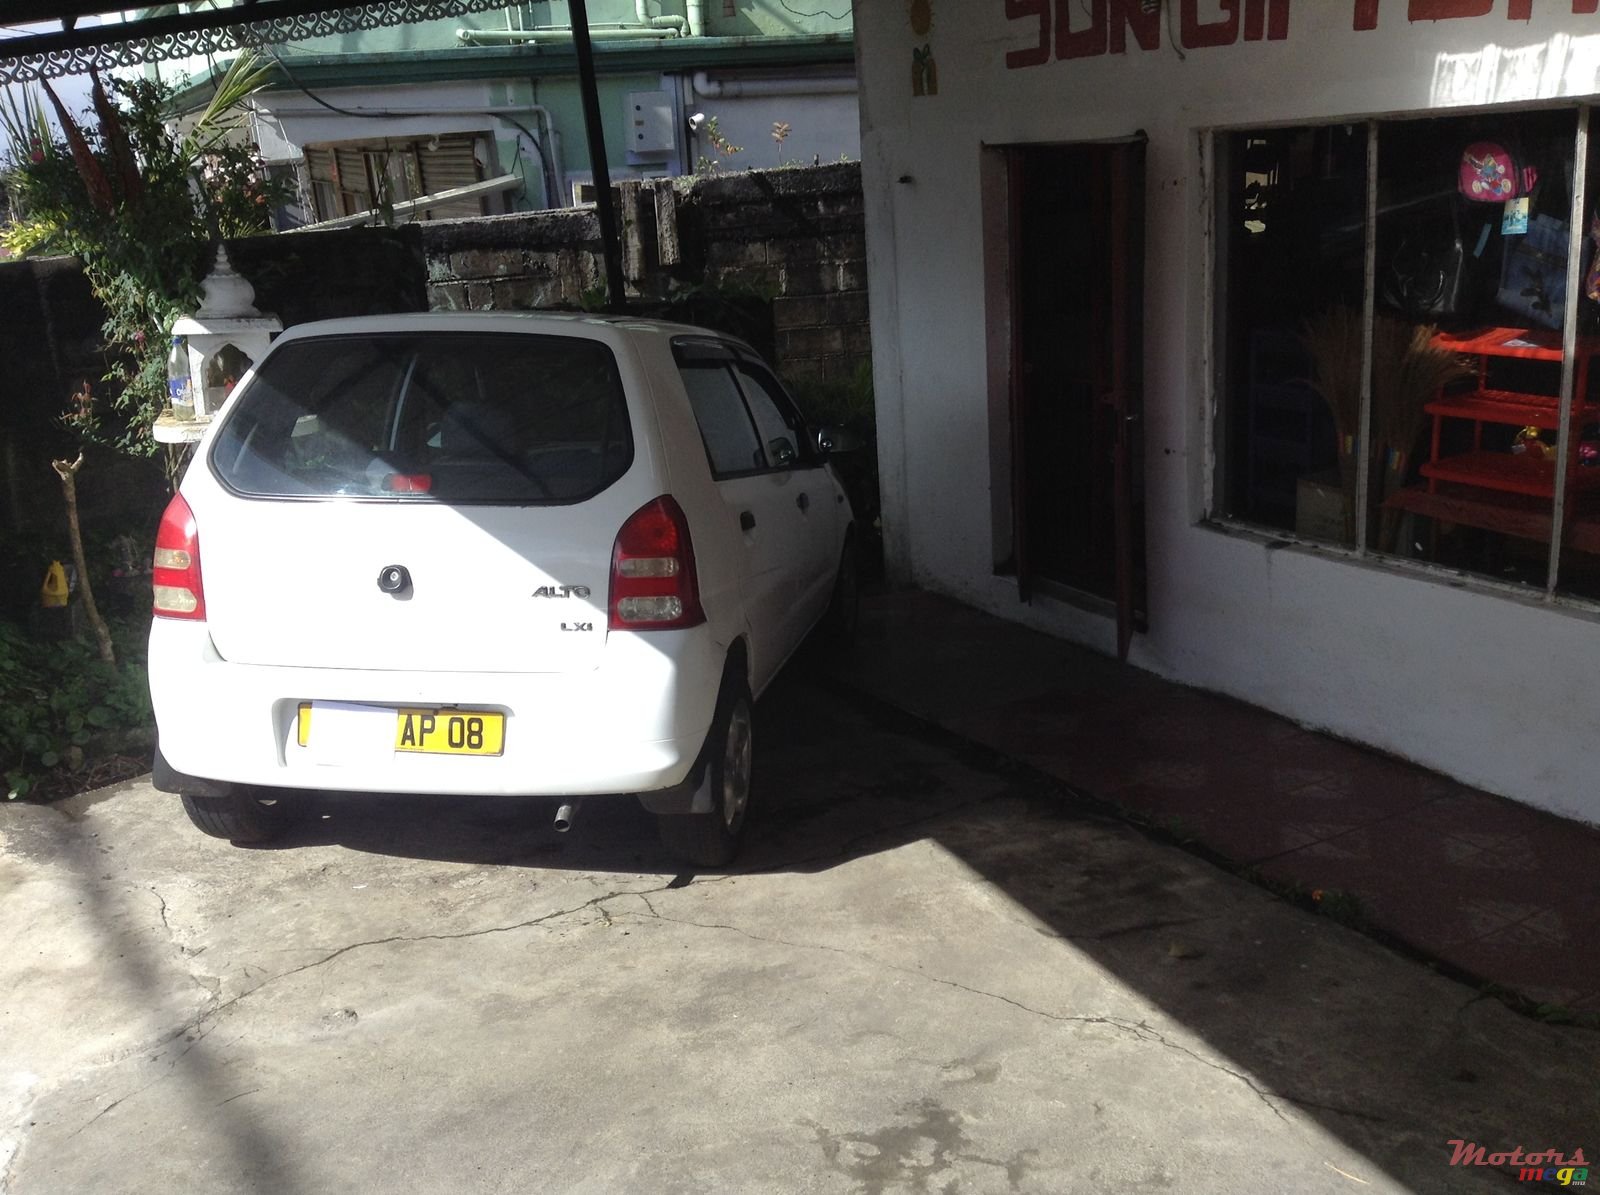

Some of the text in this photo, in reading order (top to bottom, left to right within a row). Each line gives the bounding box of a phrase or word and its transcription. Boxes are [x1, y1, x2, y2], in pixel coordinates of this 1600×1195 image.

[532, 585, 591, 599] ALTO
[401, 713, 483, 750] AP 08
